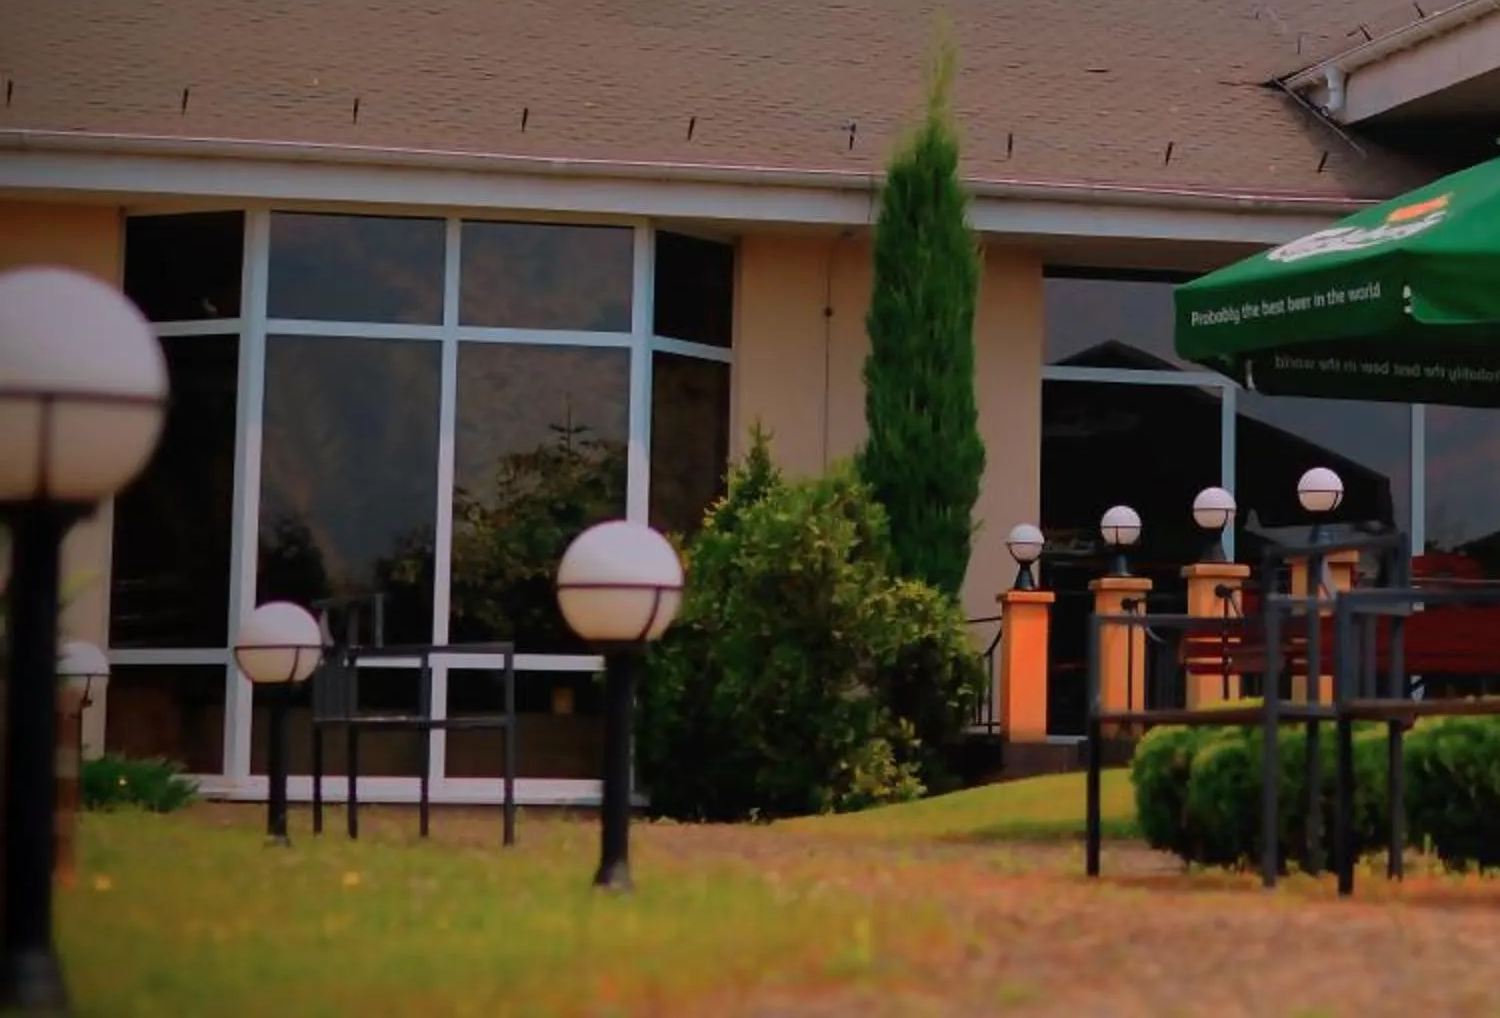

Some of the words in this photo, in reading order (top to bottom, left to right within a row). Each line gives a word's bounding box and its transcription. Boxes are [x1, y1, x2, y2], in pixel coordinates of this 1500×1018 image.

[1191, 306, 1240, 326] Probably
[1242, 302, 1260, 319] the
[1261, 299, 1285, 316] best
[1287, 296, 1312, 311] beer
[1314, 293, 1325, 307] in
[1326, 288, 1345, 304] the
[1347, 282, 1381, 302] world
